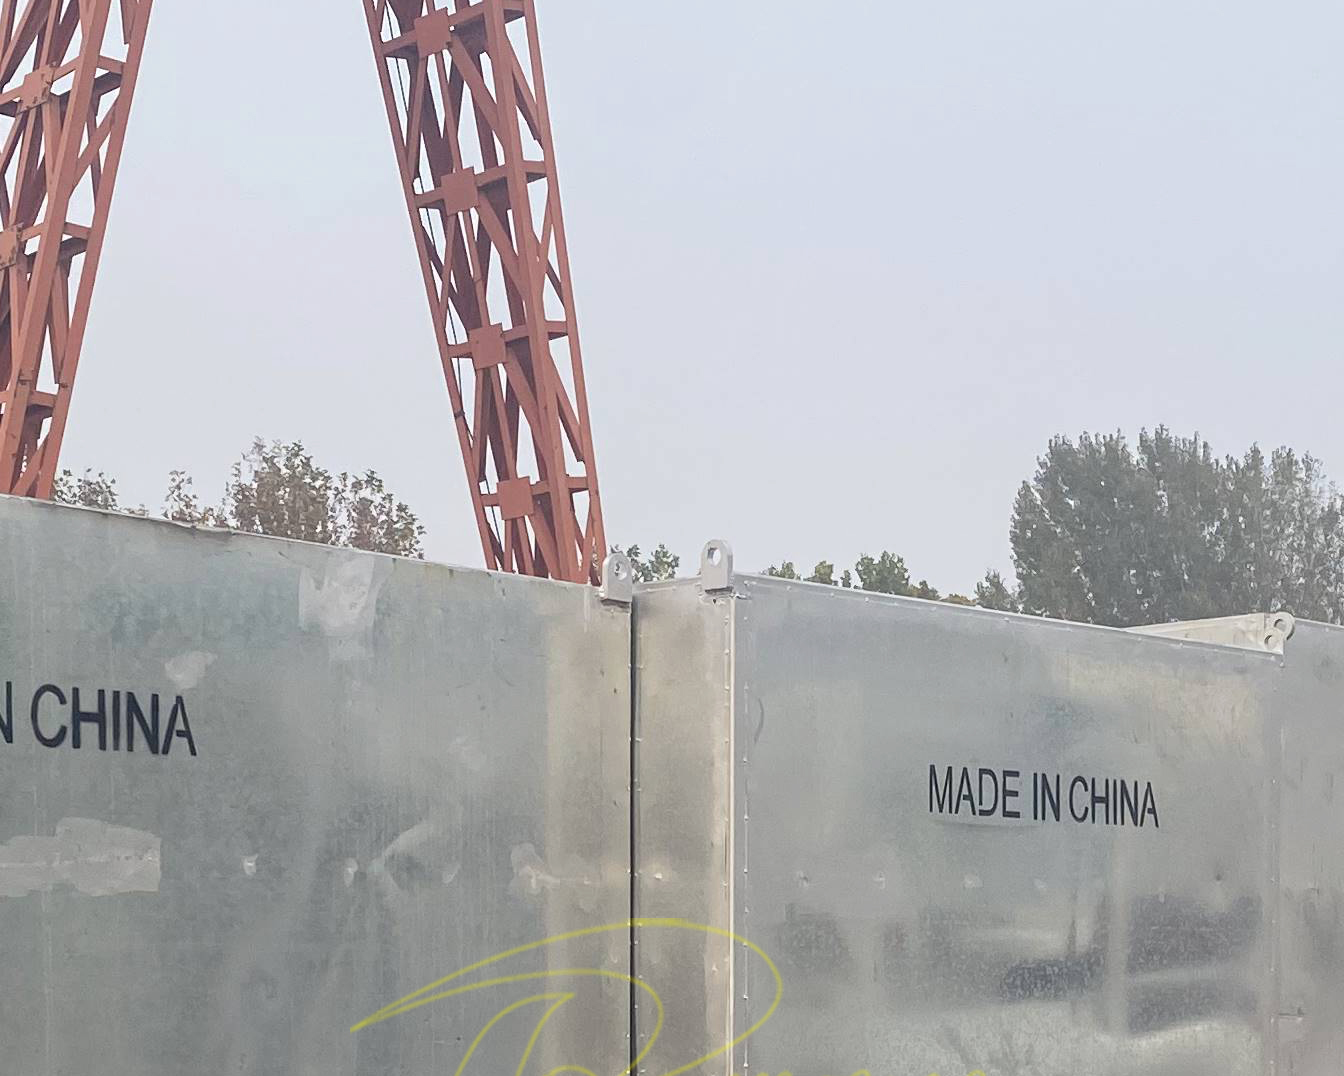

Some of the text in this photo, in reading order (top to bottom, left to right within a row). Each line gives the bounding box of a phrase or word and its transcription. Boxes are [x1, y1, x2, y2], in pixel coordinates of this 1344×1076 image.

[30, 683, 197, 756] CHINA
[928, 763, 1159, 828] MADE IN CHINA
